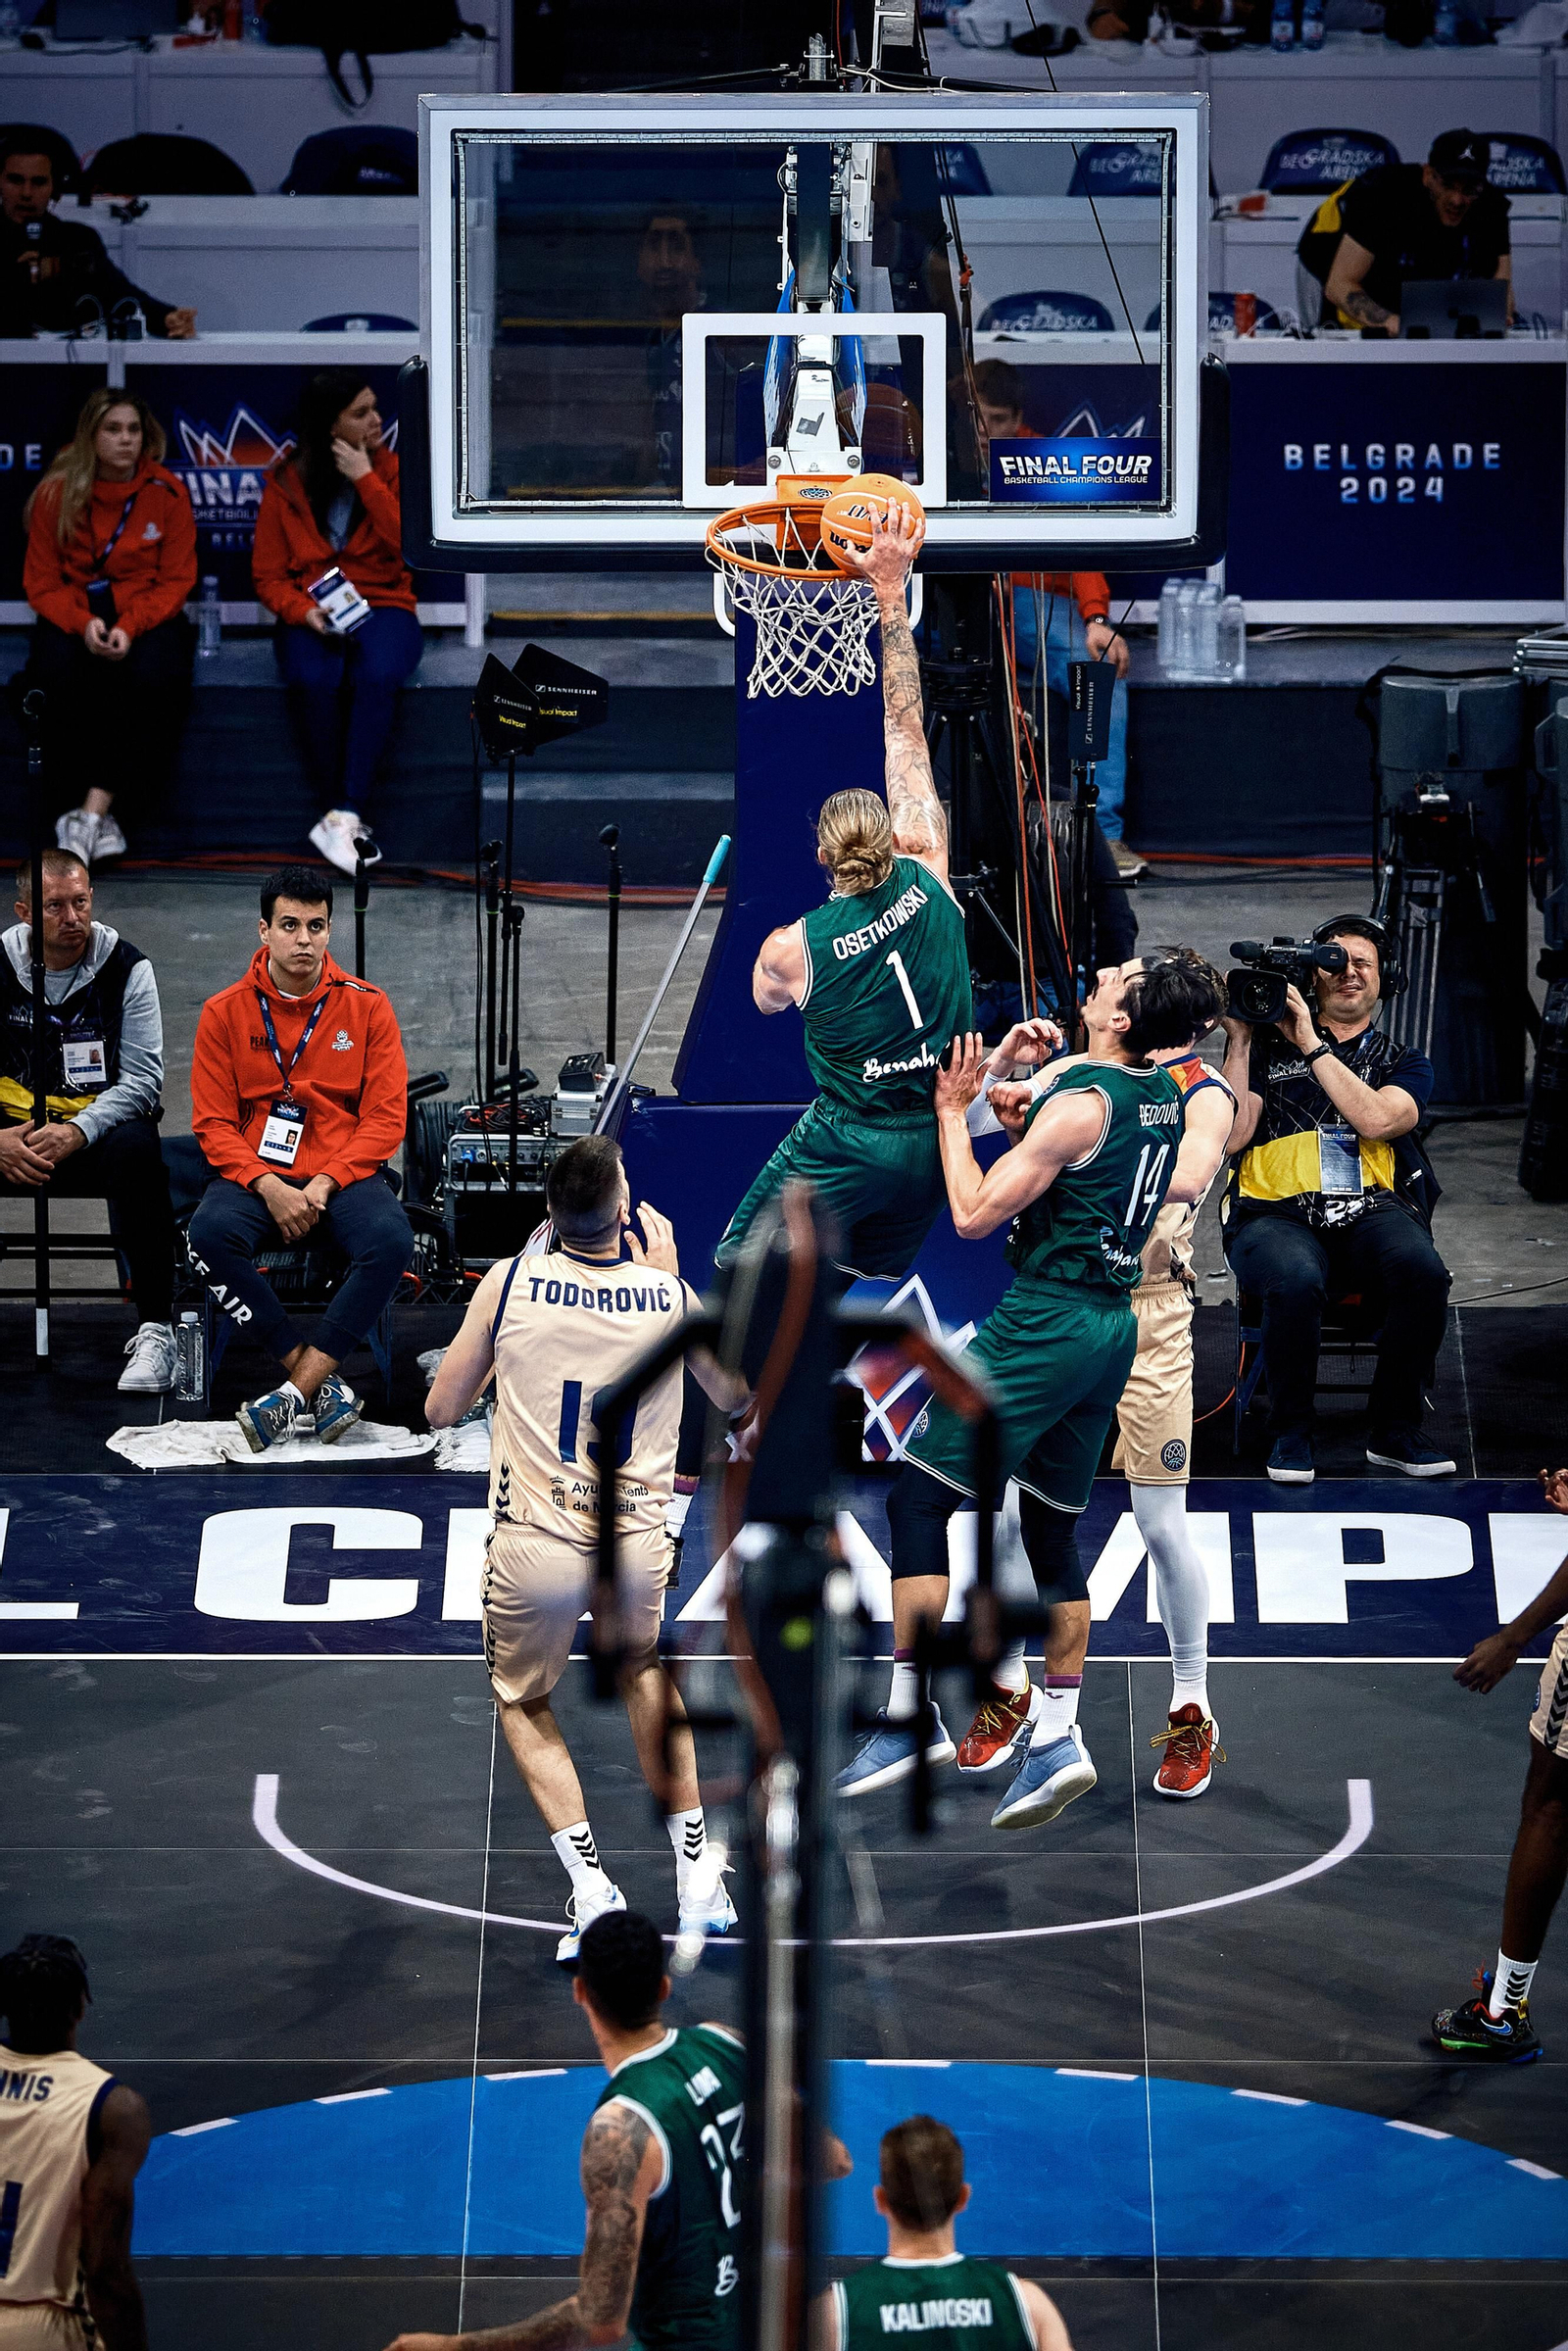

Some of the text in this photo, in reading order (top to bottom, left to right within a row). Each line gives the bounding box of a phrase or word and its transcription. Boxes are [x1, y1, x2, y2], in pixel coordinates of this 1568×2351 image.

[1000, 456, 1152, 476] FINAL FOUR
[1284, 443, 1500, 469] BELGRADE
[174, 471, 263, 506] INA
[1340, 476, 1444, 504] 2024
[547, 686, 598, 696] SENNHEISER
[832, 884, 929, 960] OSETKOWSKI
[886, 949, 924, 1030] 1
[1124, 1144, 1171, 1226] 14
[208, 1285, 253, 1326] AIR
[529, 1277, 671, 1313] TODOROVIĆ
[571, 1481, 649, 1497] Ayuiento
[572, 1500, 589, 1512] de
[879, 2297, 994, 2332] KALINOSKI
